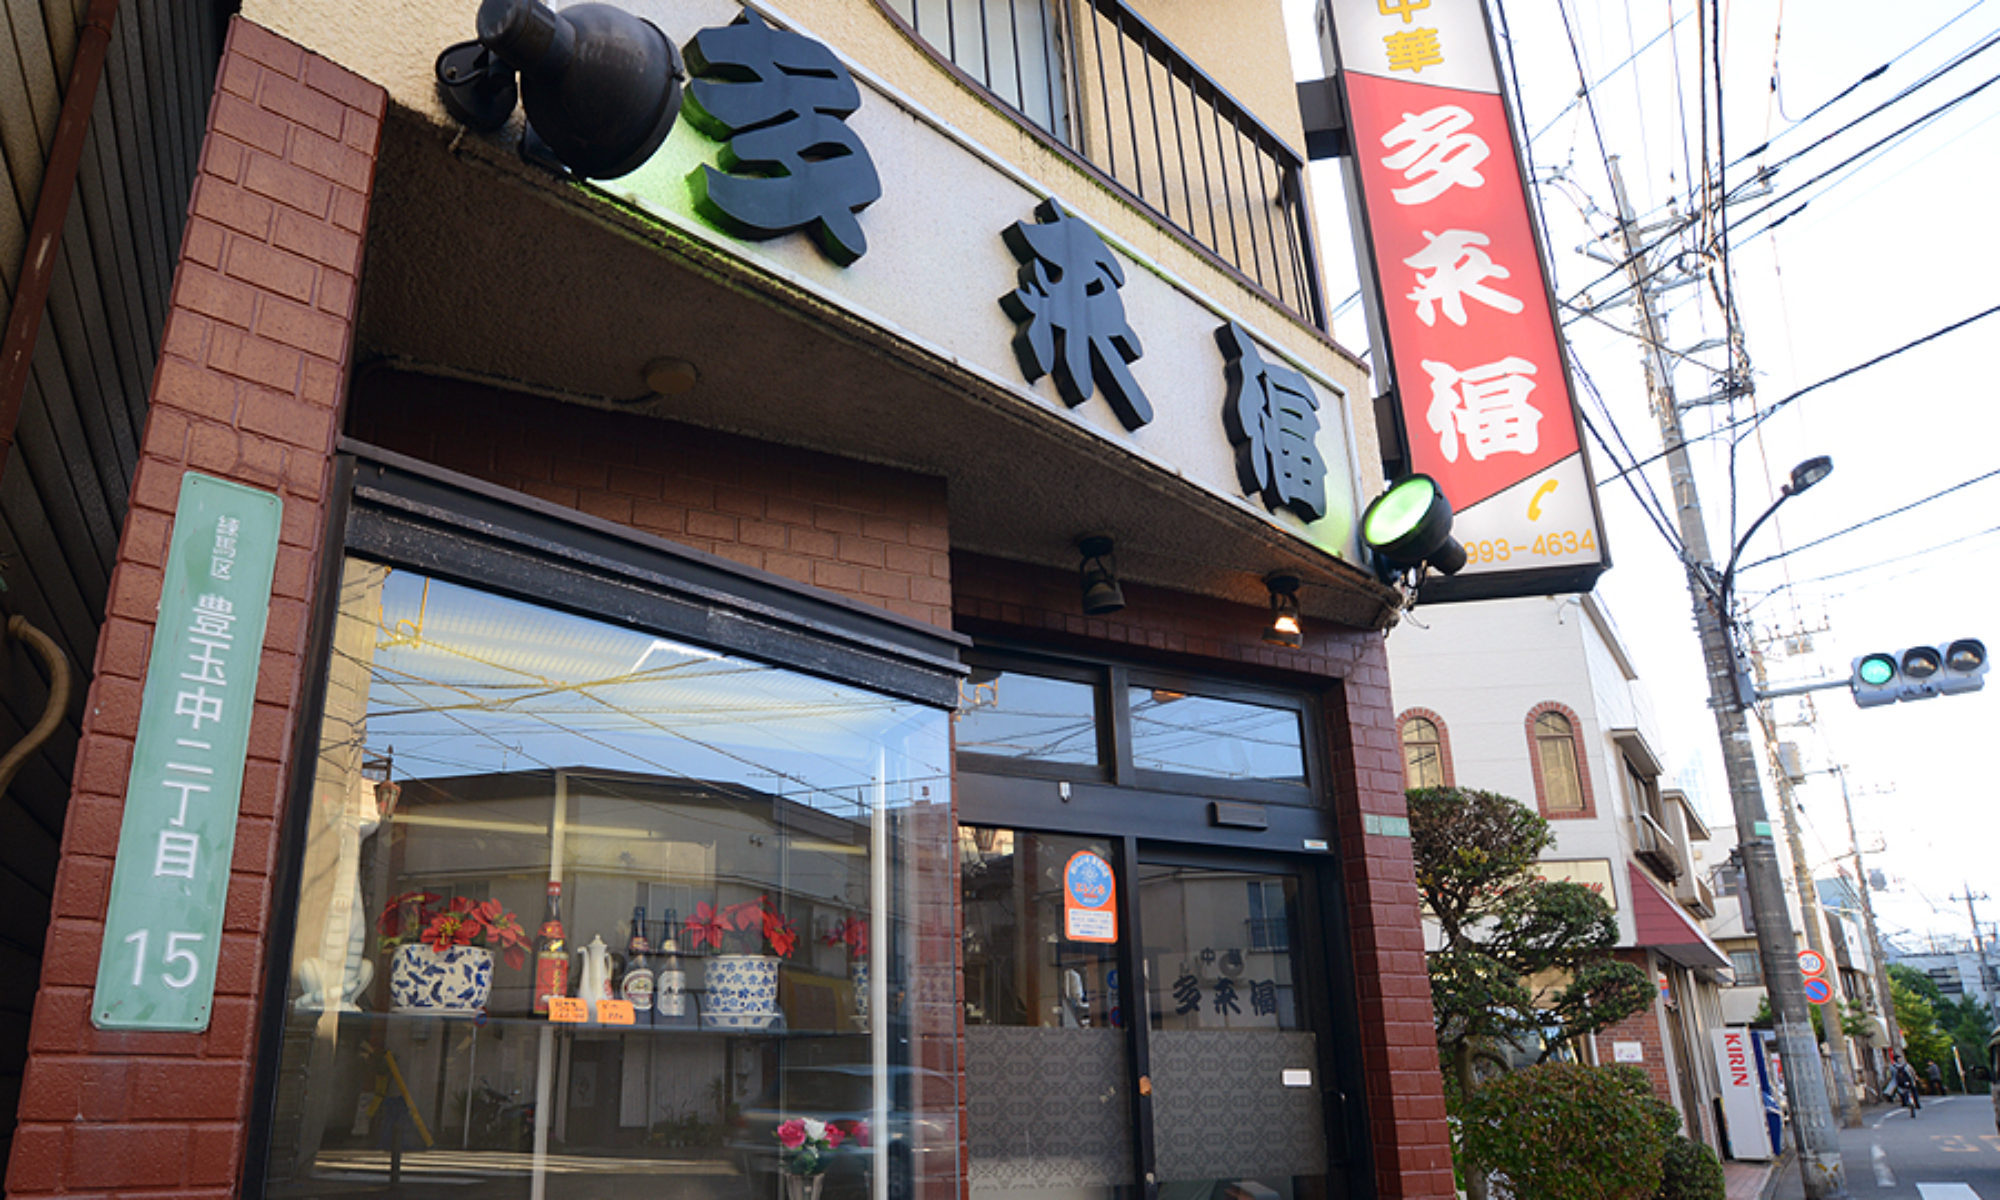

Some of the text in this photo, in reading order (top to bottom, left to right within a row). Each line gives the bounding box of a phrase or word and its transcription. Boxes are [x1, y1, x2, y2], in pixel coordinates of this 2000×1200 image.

[682, 5, 1328, 525] 多来福
[1380, 105, 1543, 463] 多来福
[124, 514, 240, 988] 練馬区 豊玉中二丁目 15
[1724, 1033, 1749, 1087] KIRIN
